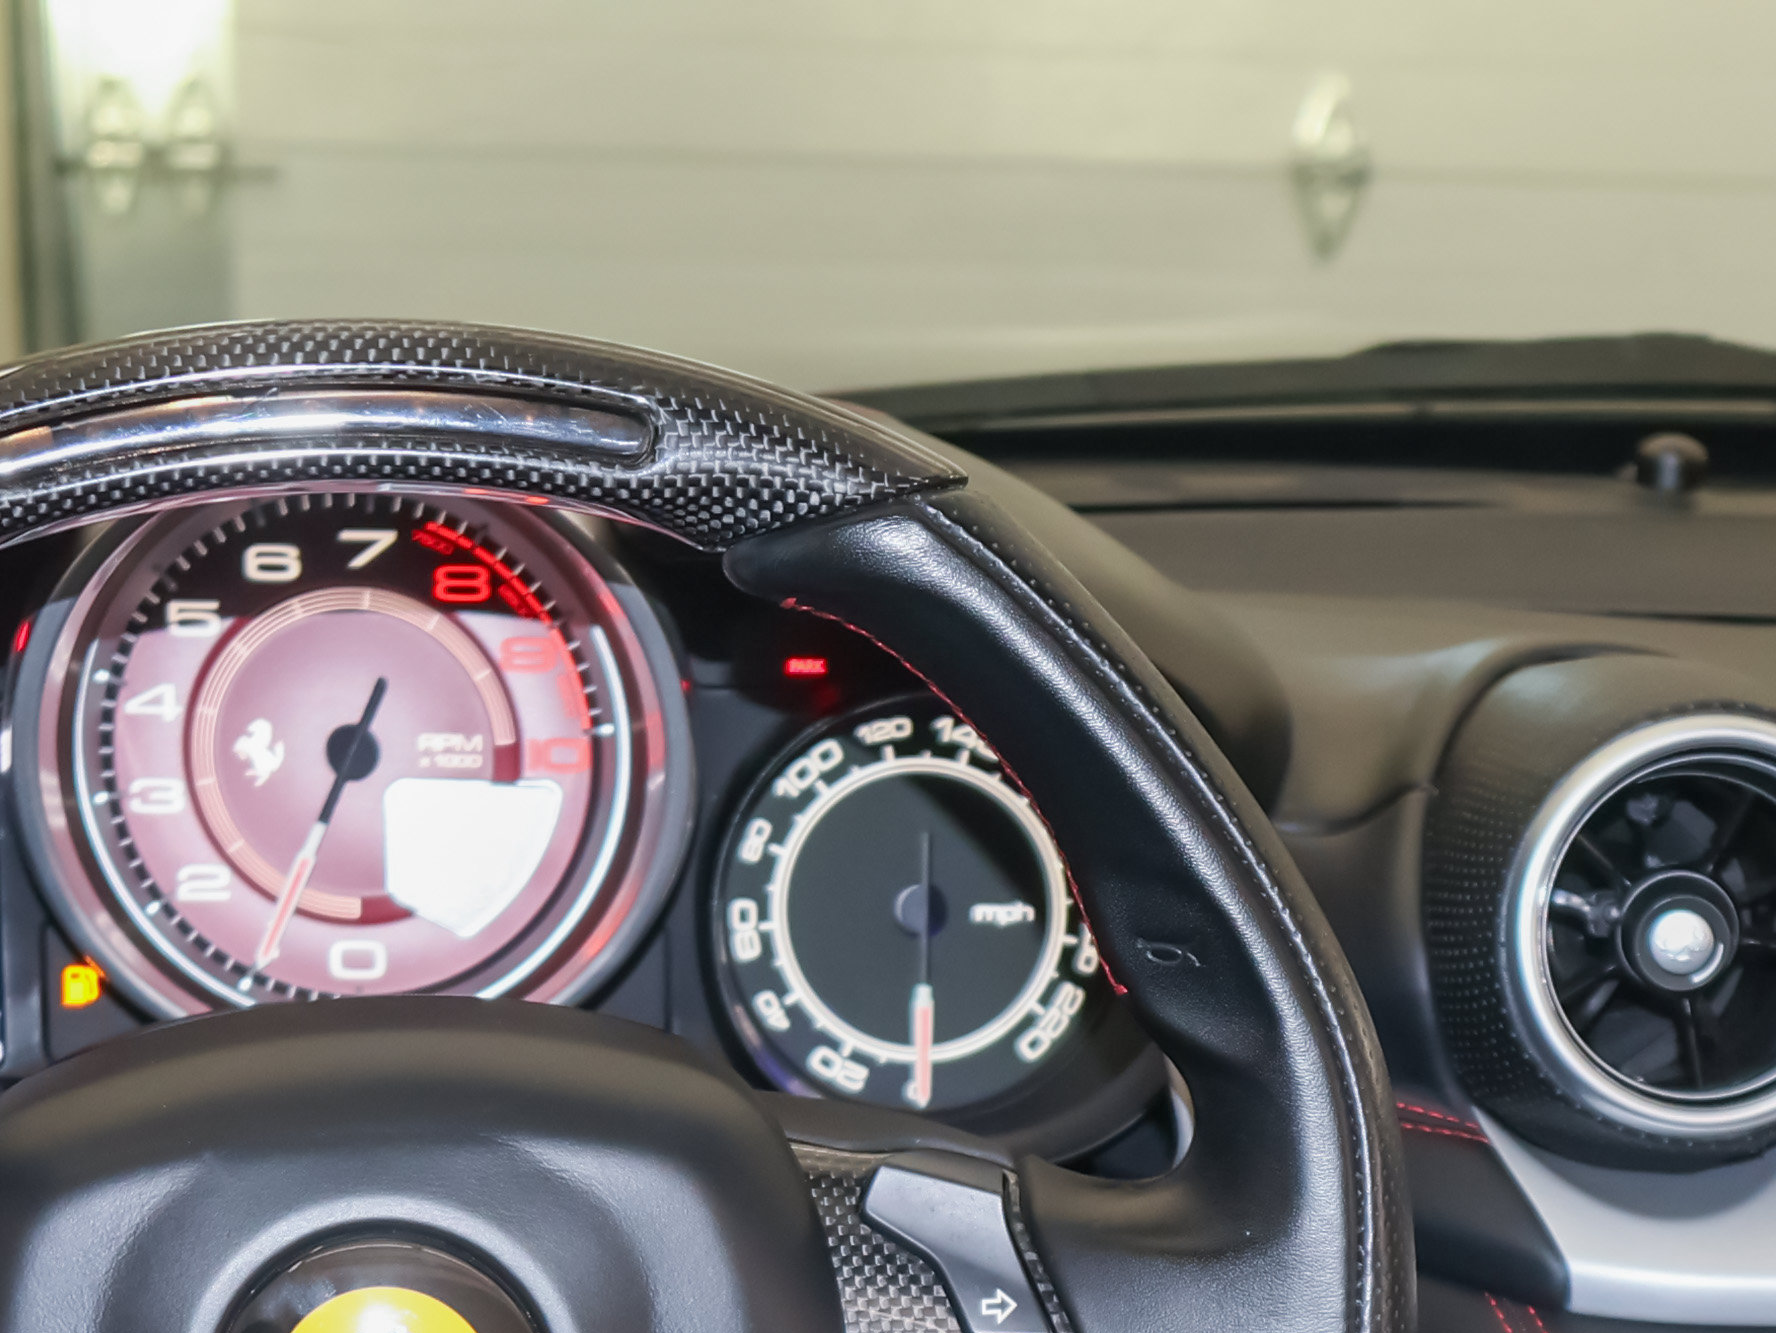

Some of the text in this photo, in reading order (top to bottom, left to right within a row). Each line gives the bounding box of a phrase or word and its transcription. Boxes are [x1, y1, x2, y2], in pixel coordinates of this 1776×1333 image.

[242, 543, 303, 582] 6
[336, 530, 397, 570] 7
[433, 563, 491, 604] 8
[166, 600, 224, 638] 5
[123, 684, 184, 723] 4
[417, 733, 484, 752] RPM
[854, 716, 913, 745] 120
[527, 737, 593, 774] 10
[772, 738, 845, 798] 100
[128, 777, 186, 815] 3
[737, 817, 774, 864] 80
[175, 863, 231, 901] 2
[727, 898, 763, 963] 60
[969, 901, 1036, 927] mph
[328, 939, 387, 980] 0
[751, 989, 791, 1032] 40
[1014, 980, 1086, 1063] 220
[805, 1044, 870, 1095] 20
